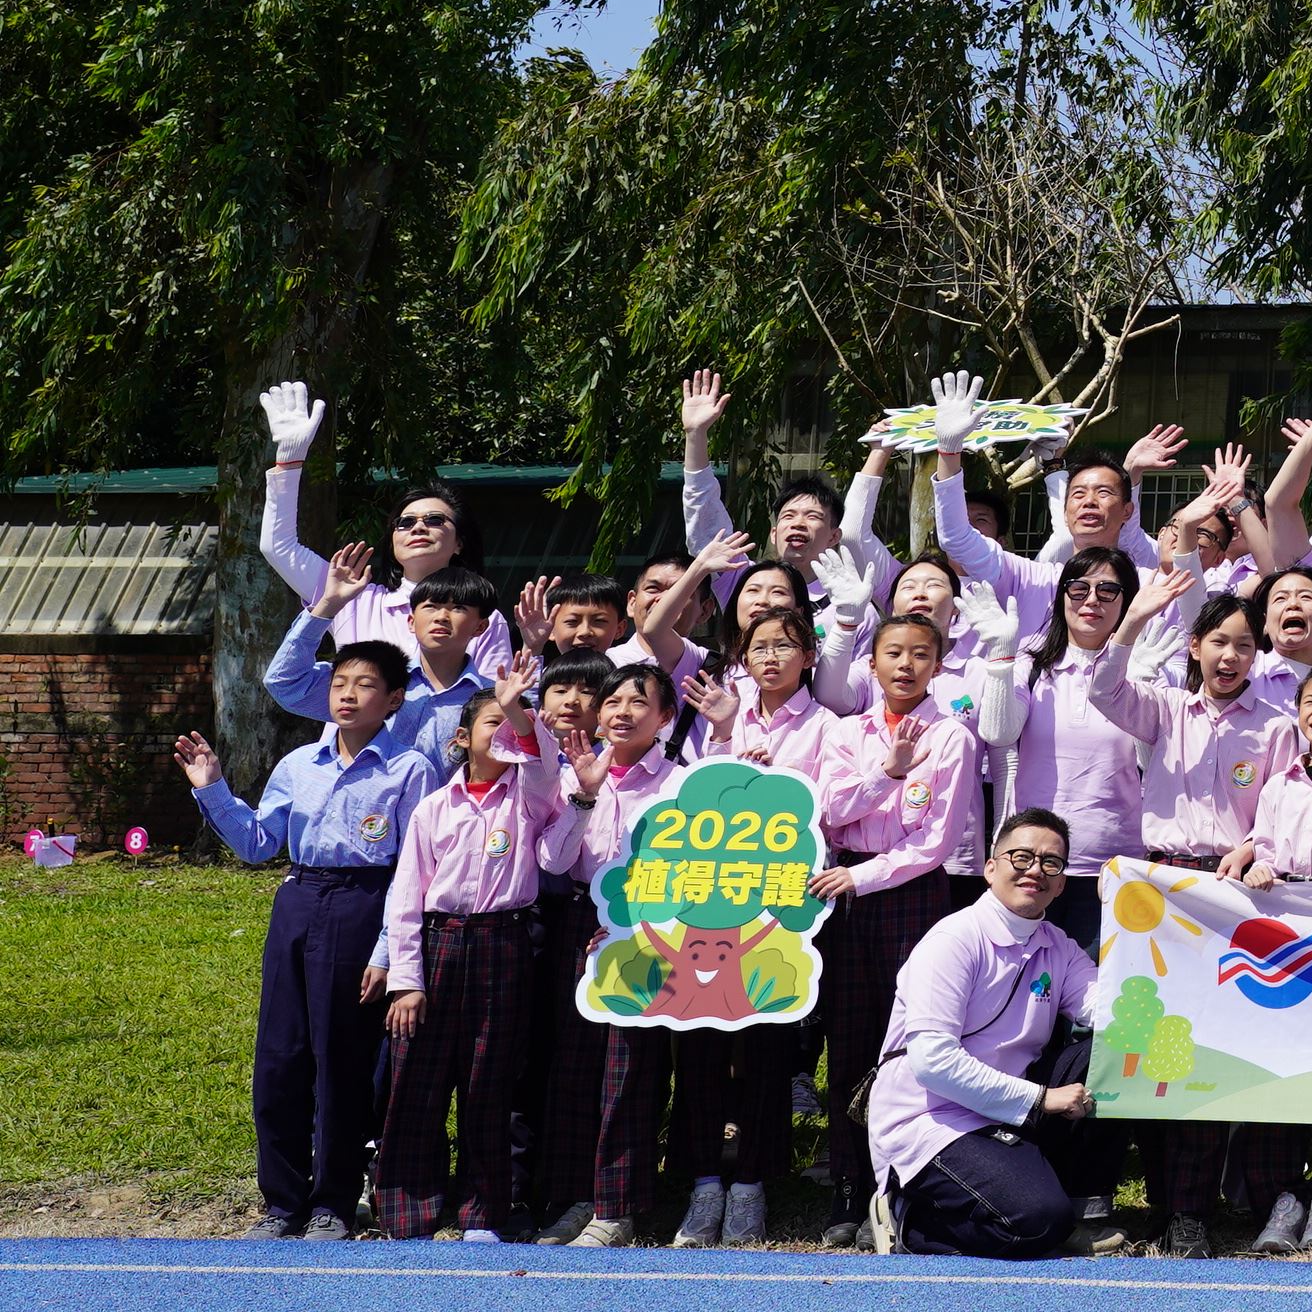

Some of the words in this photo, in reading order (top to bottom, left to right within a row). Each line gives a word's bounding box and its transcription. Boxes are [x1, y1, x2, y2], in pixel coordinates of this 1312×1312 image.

[129, 832, 143, 849] 8
[650, 809, 799, 852] 2026
[622, 858, 810, 907] 植得守護
